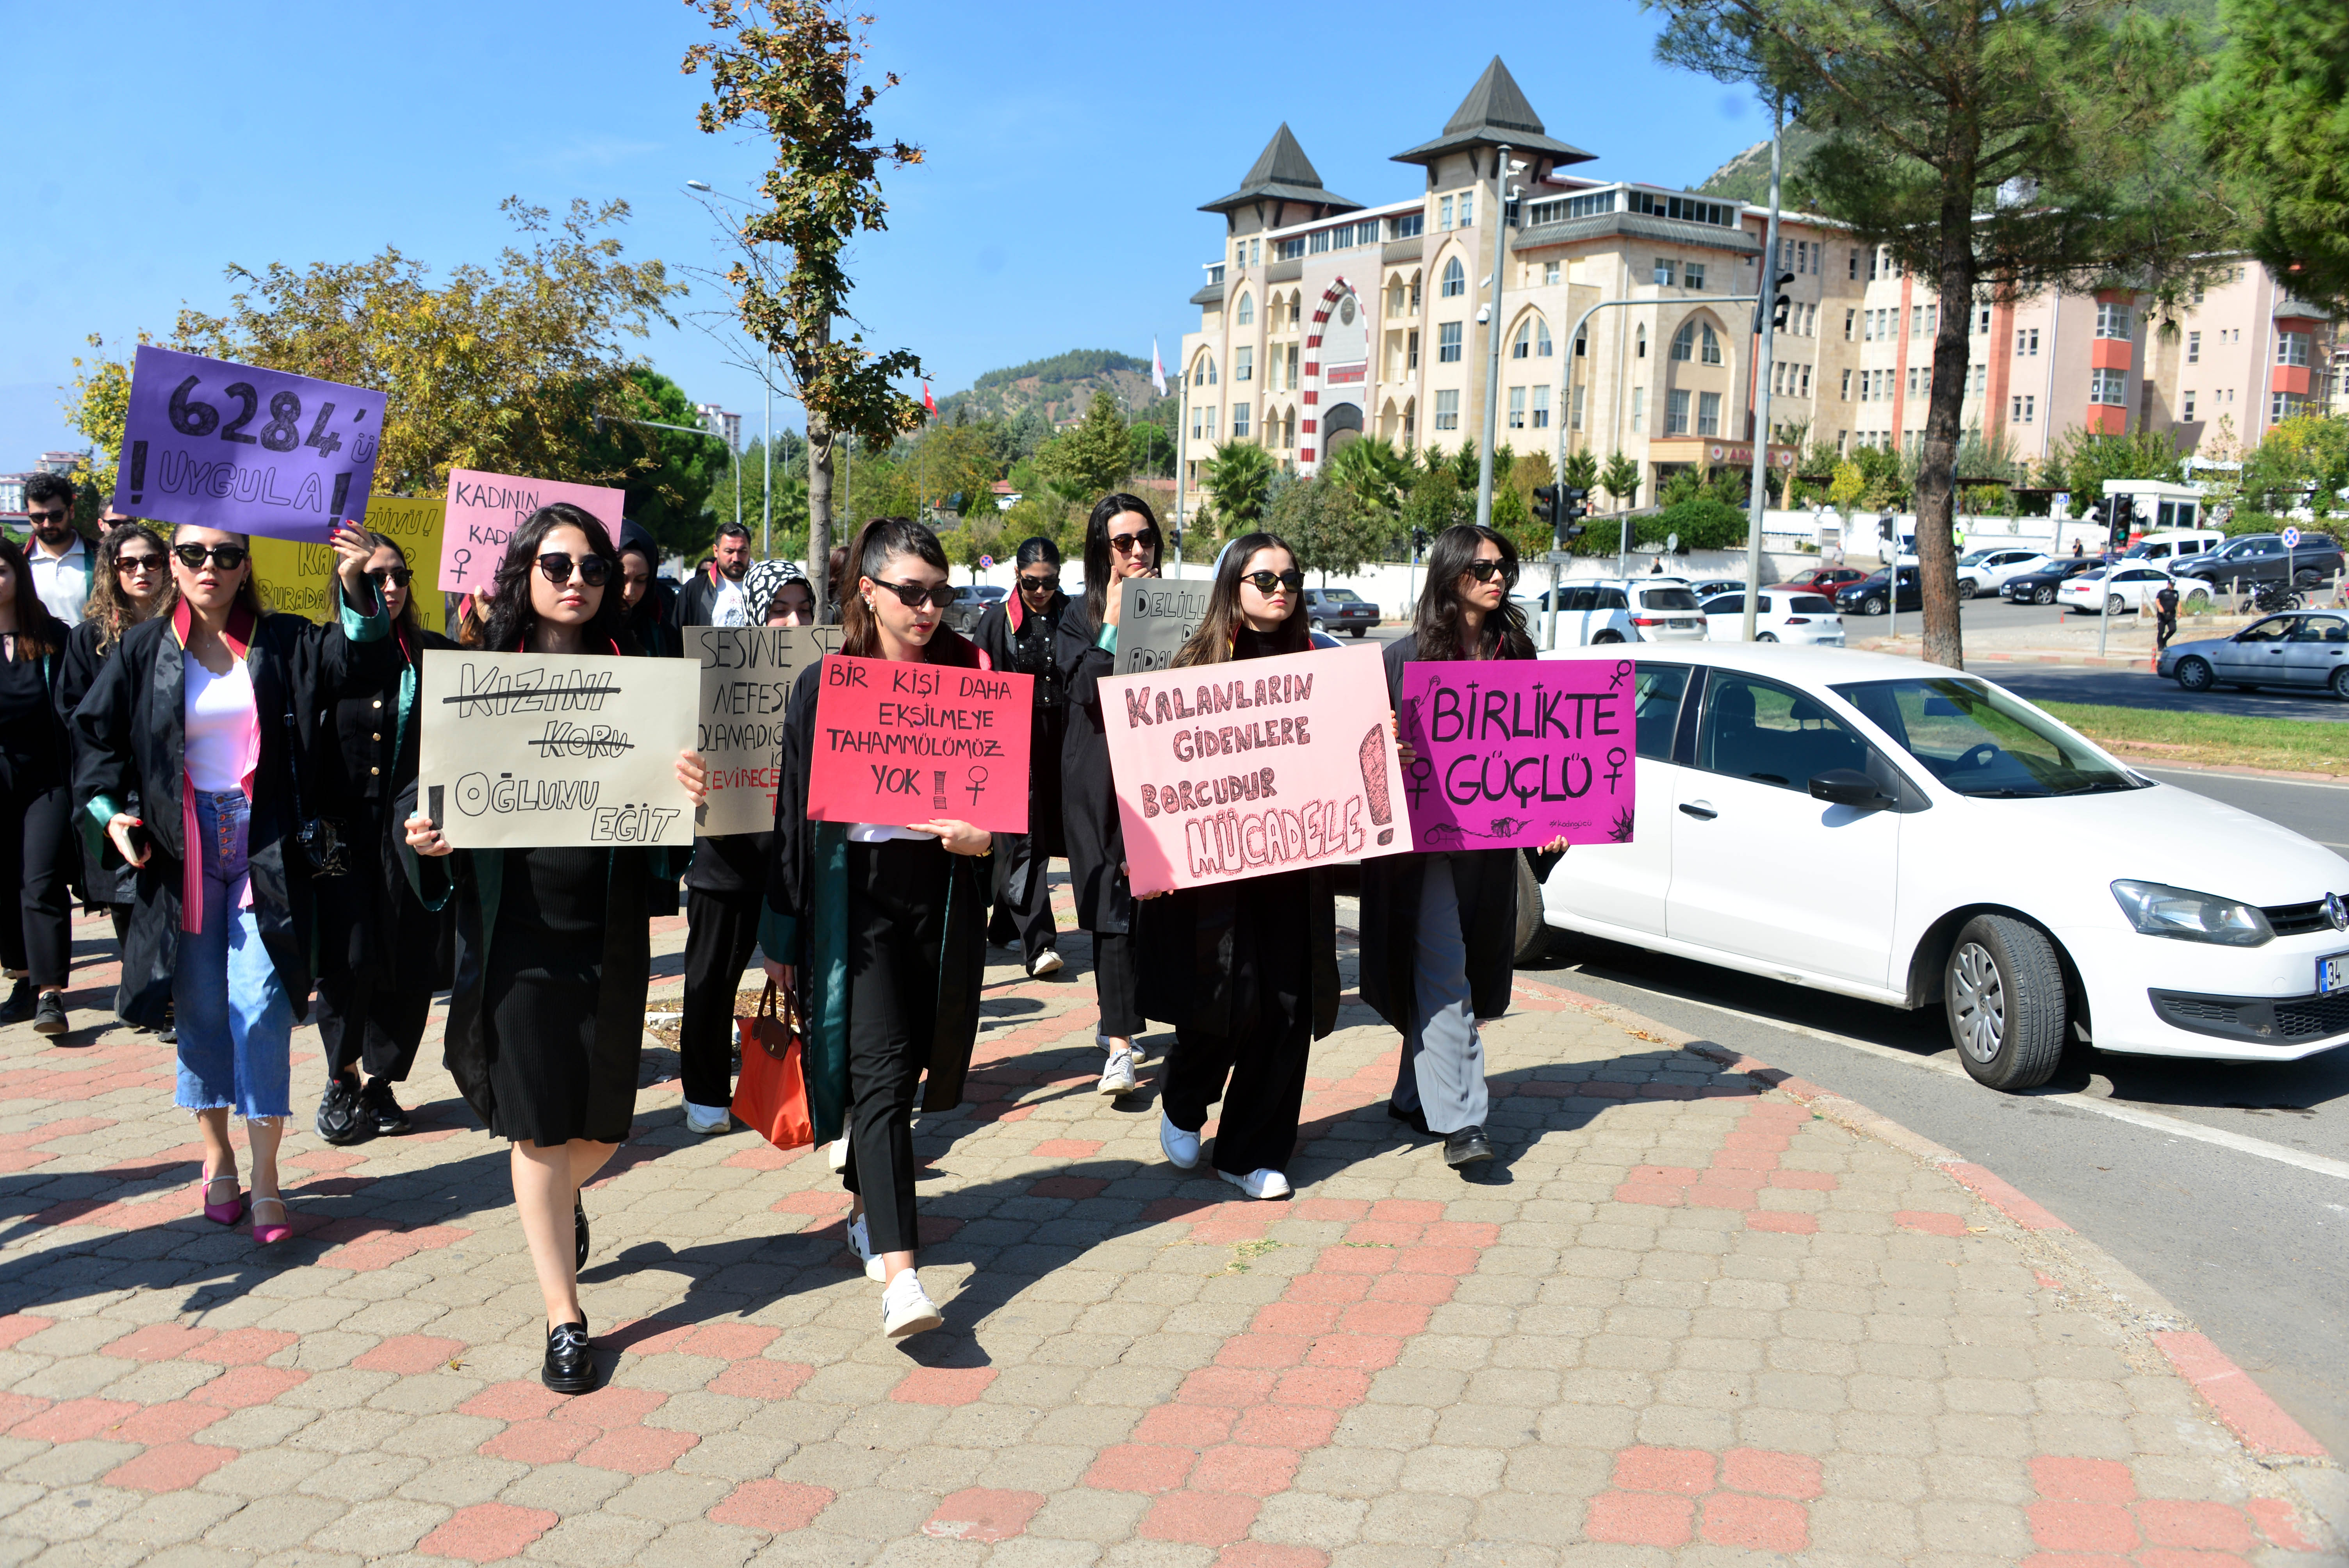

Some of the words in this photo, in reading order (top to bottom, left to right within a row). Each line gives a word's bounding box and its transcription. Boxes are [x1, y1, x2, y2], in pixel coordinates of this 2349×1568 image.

[1730, 448, 1775, 462] ADLE
[456, 482, 539, 510] KADININ
[701, 629, 793, 669] SESİNE
[460, 663, 612, 718] KIZINI
[829, 659, 868, 688] BİR
[892, 668, 940, 698] KİŞİ
[959, 677, 1012, 700] DAHA
[879, 702, 994, 730] EKSİLMEYE
[1125, 673, 1313, 729] KALANLARIN
[1432, 680, 1620, 742] BİRLİKTE
[541, 720, 627, 758] KORU
[827, 728, 1005, 759] TAHAMMÜLÜMÜZ
[1173, 716, 1311, 762] GİDENLERE
[455, 772, 599, 816] OĞLUNU
[703, 766, 781, 796] EVİRECE
[871, 764, 921, 796] YOK
[1141, 767, 1278, 818] BORCUDUR
[1445, 750, 1592, 809] GÜÇLÜ
[591, 803, 681, 842] EĞİT
